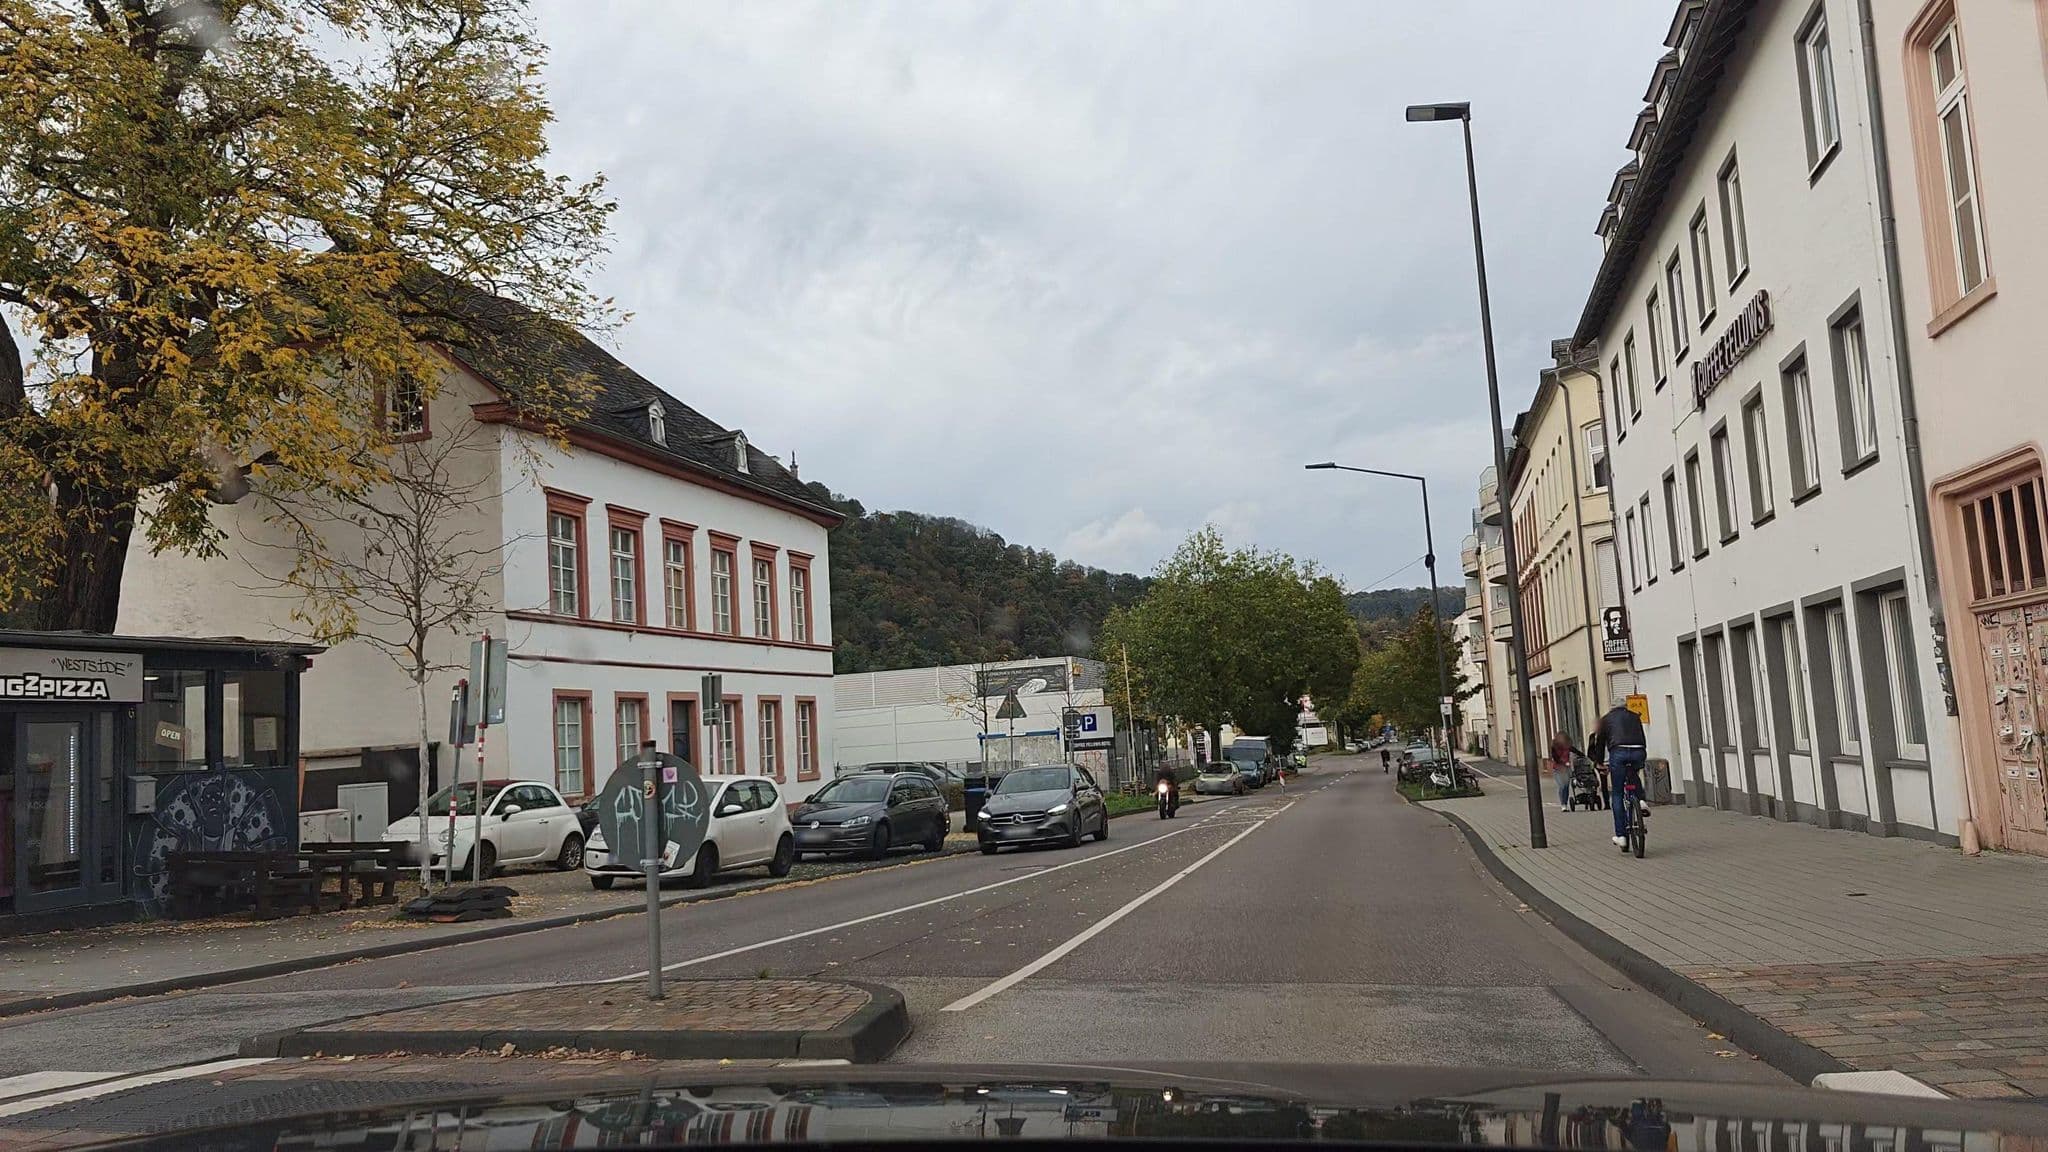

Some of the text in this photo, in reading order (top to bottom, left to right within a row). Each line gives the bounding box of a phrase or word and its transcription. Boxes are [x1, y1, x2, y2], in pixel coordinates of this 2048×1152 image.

[1697, 289, 1768, 397] COFFEE FELLOWS
[1604, 638, 1628, 648] COFFEE
[1084, 716, 1093, 730] P
[161, 728, 181, 741] OPEN
